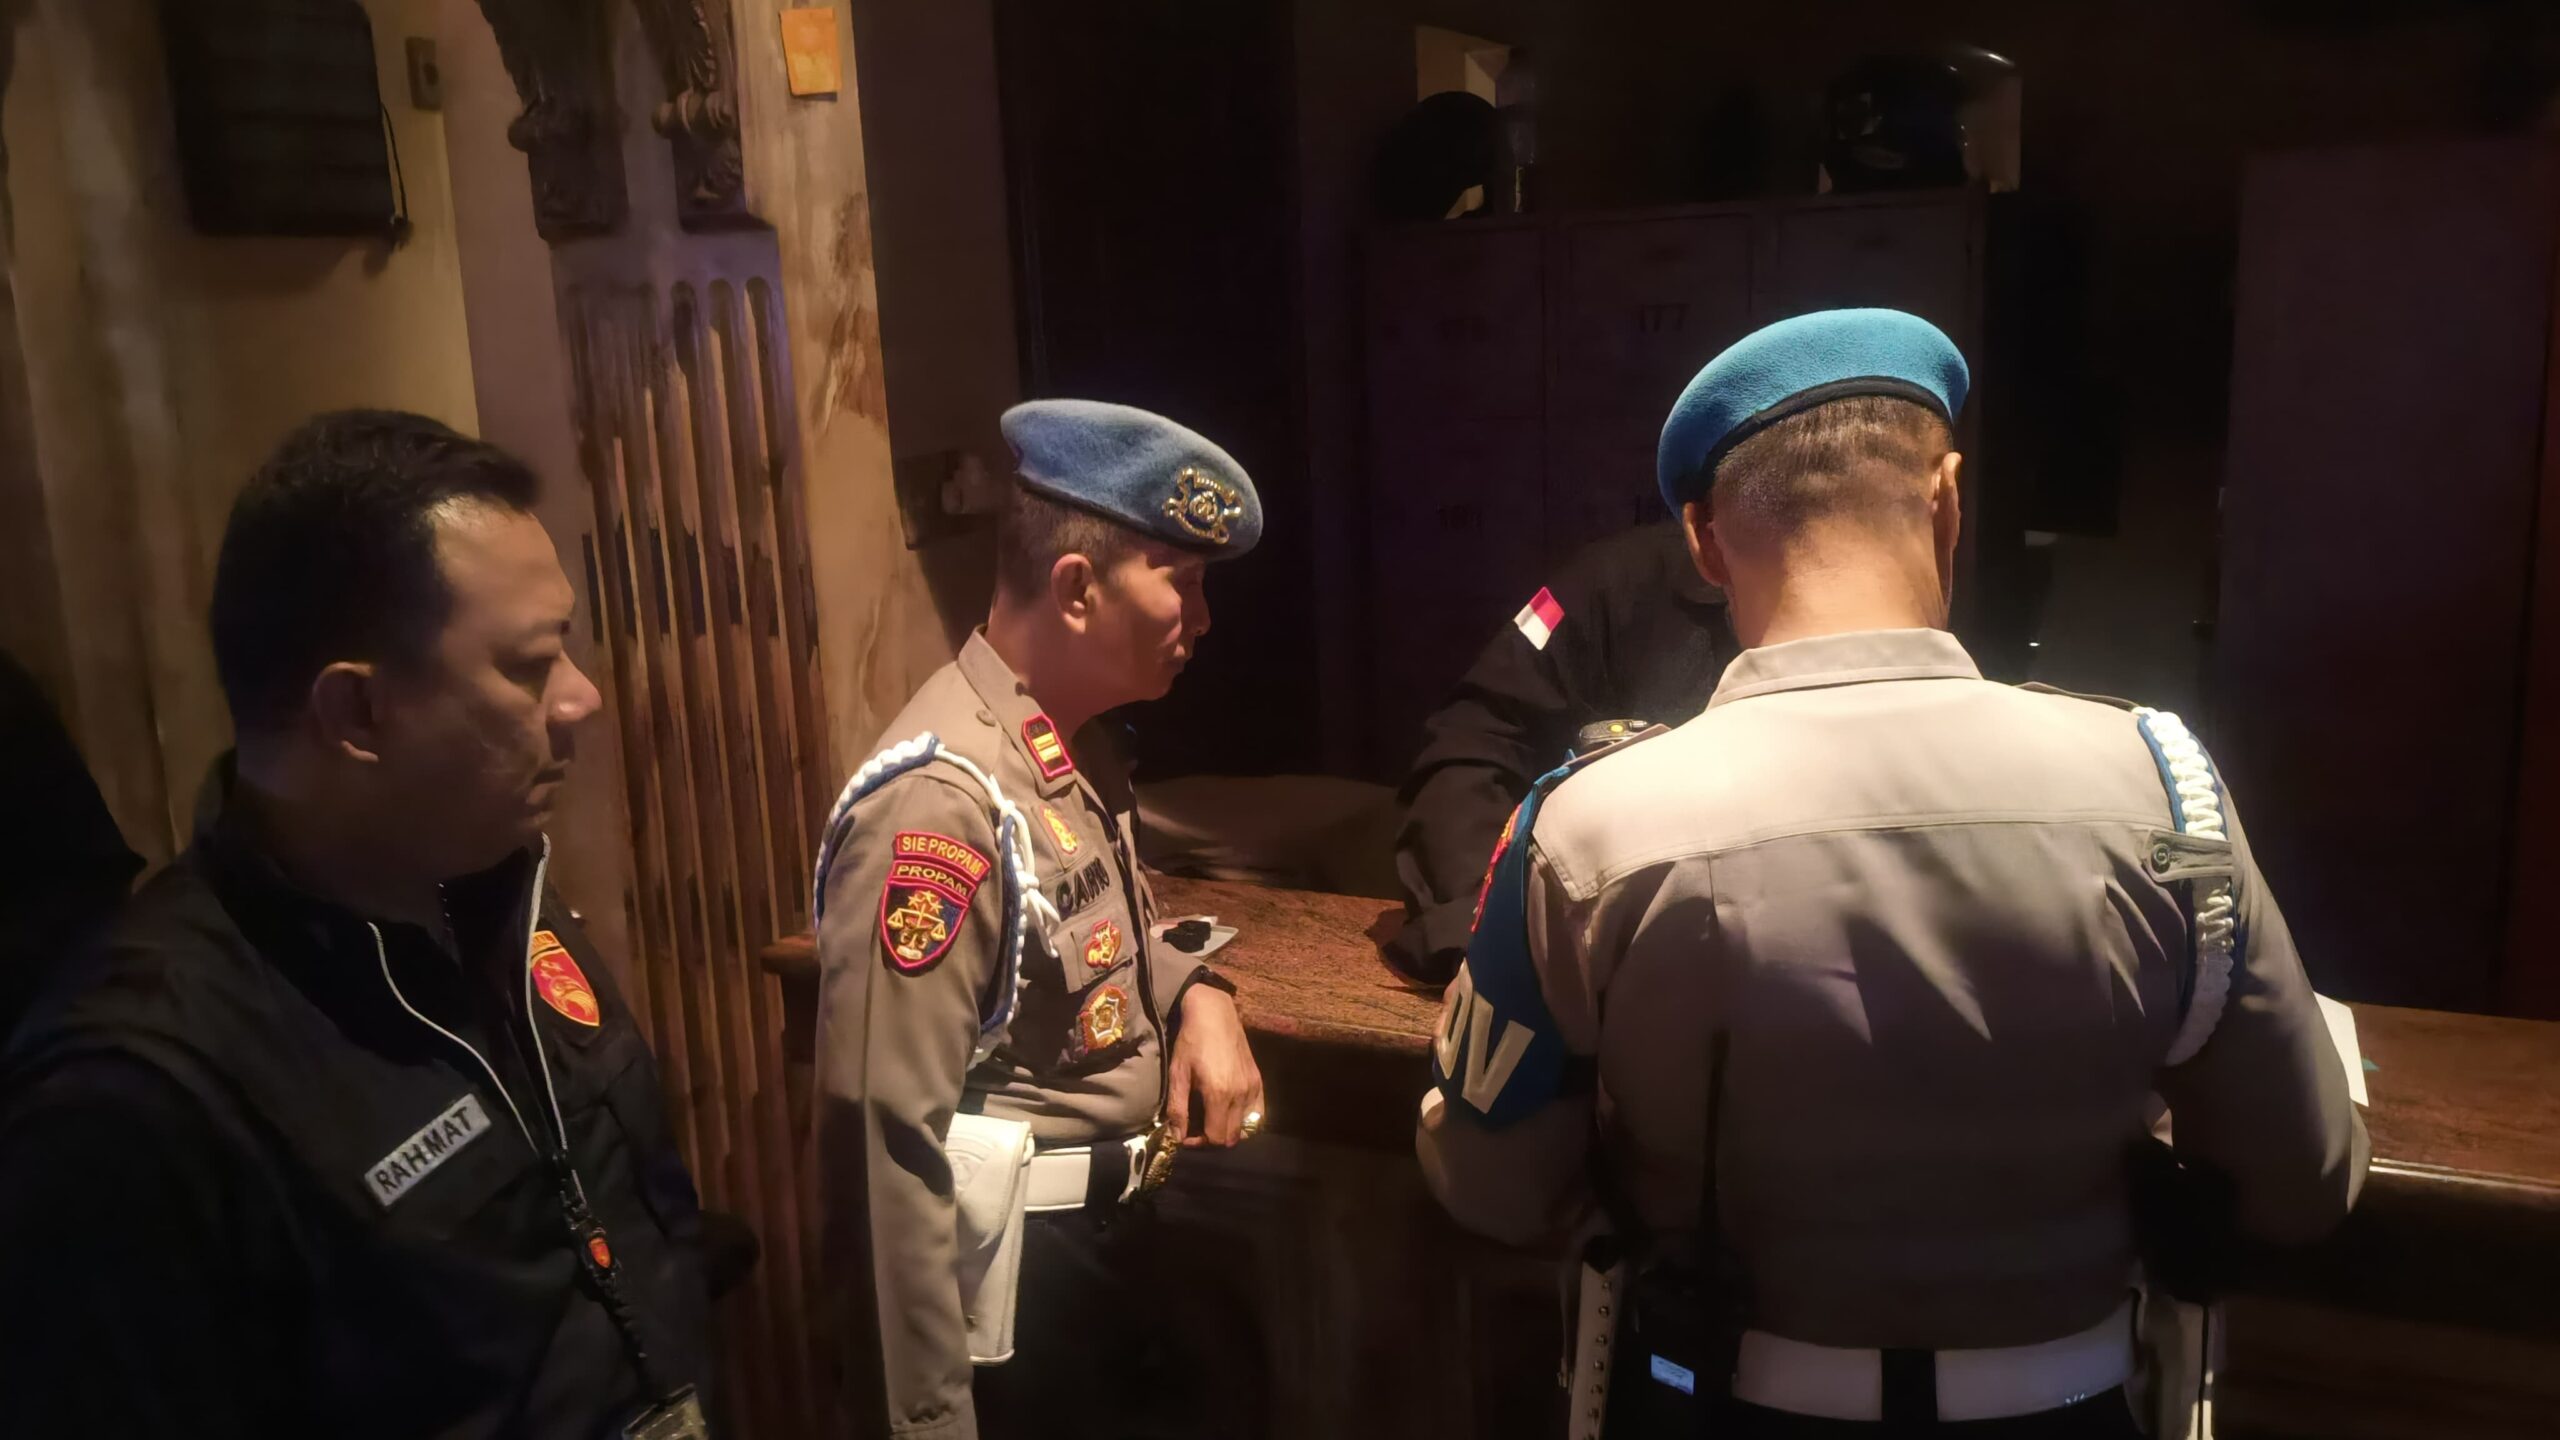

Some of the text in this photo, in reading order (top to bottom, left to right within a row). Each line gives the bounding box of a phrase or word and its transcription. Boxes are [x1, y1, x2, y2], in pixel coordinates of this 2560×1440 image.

[927, 837, 984, 877] PROPAM
[896, 864, 969, 898] PROPAM
[374, 1105, 472, 1195] RAHMAT
